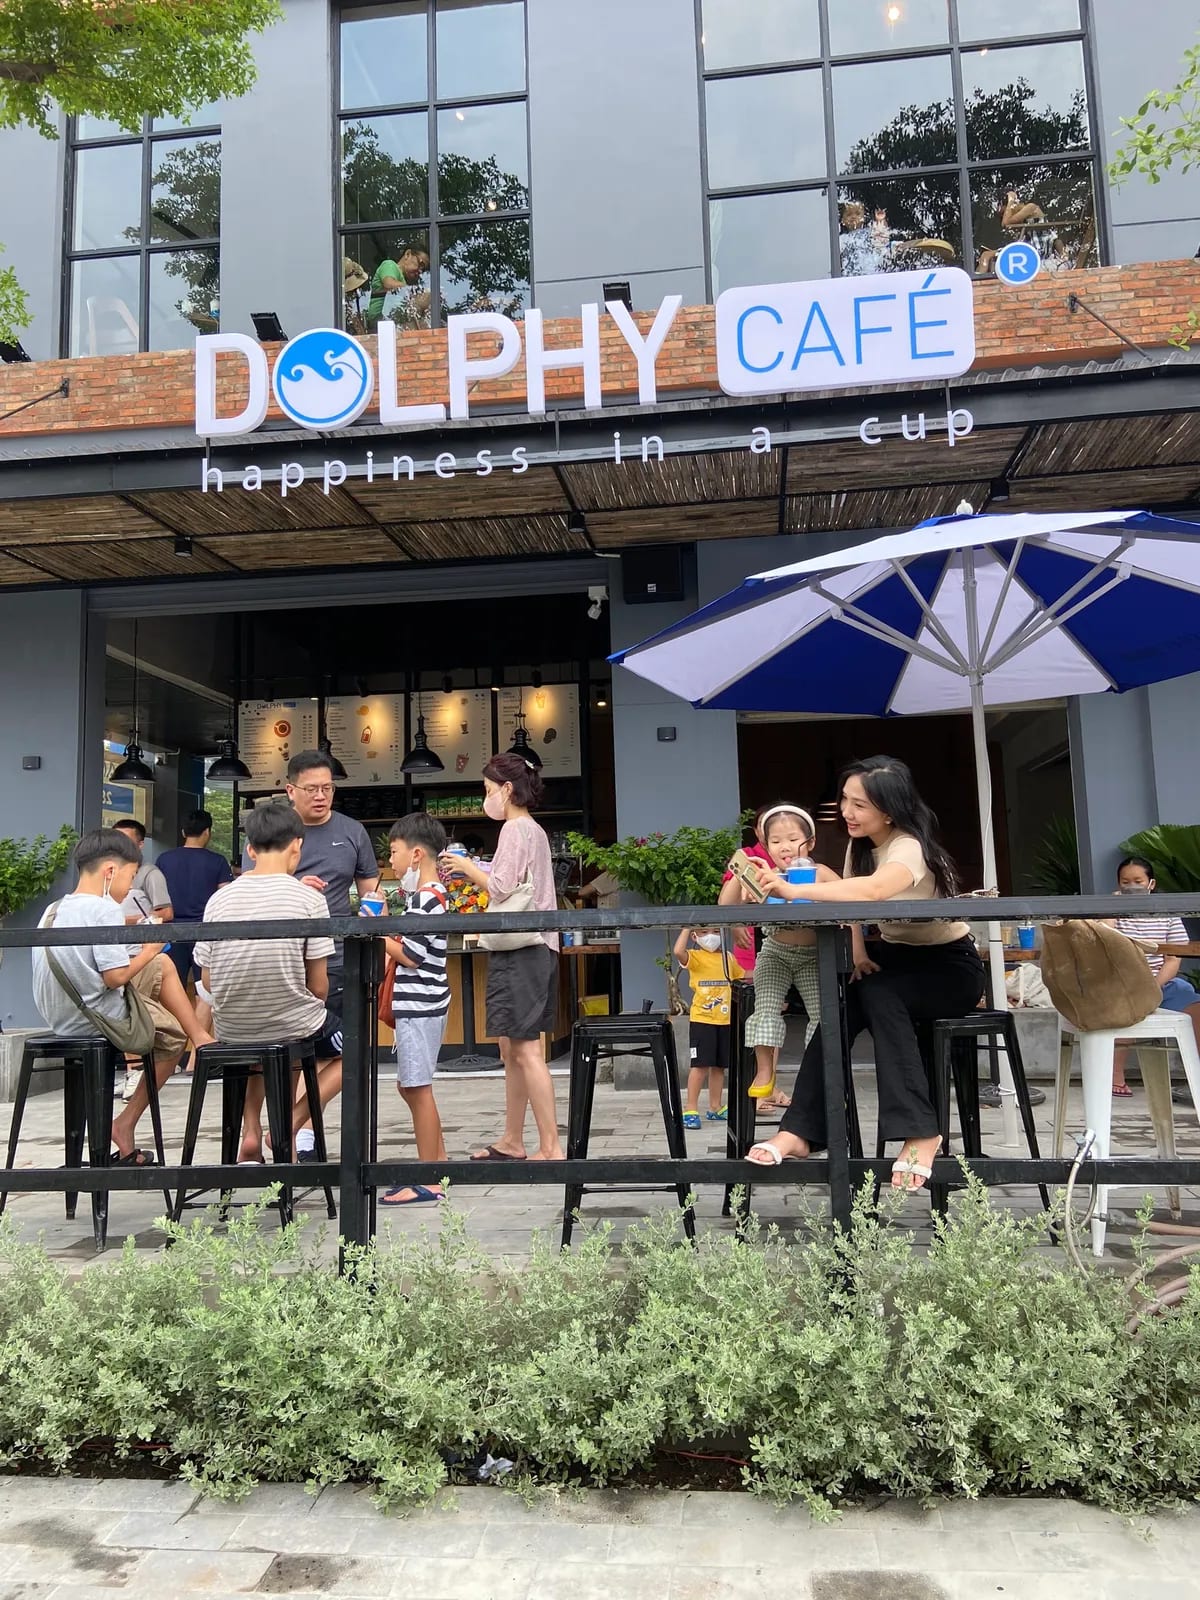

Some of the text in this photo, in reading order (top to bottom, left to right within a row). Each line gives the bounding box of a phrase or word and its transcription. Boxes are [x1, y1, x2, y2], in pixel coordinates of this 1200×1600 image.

[736, 273, 955, 374] CAFÉ
[201, 408, 975, 498] happiness in a cup
